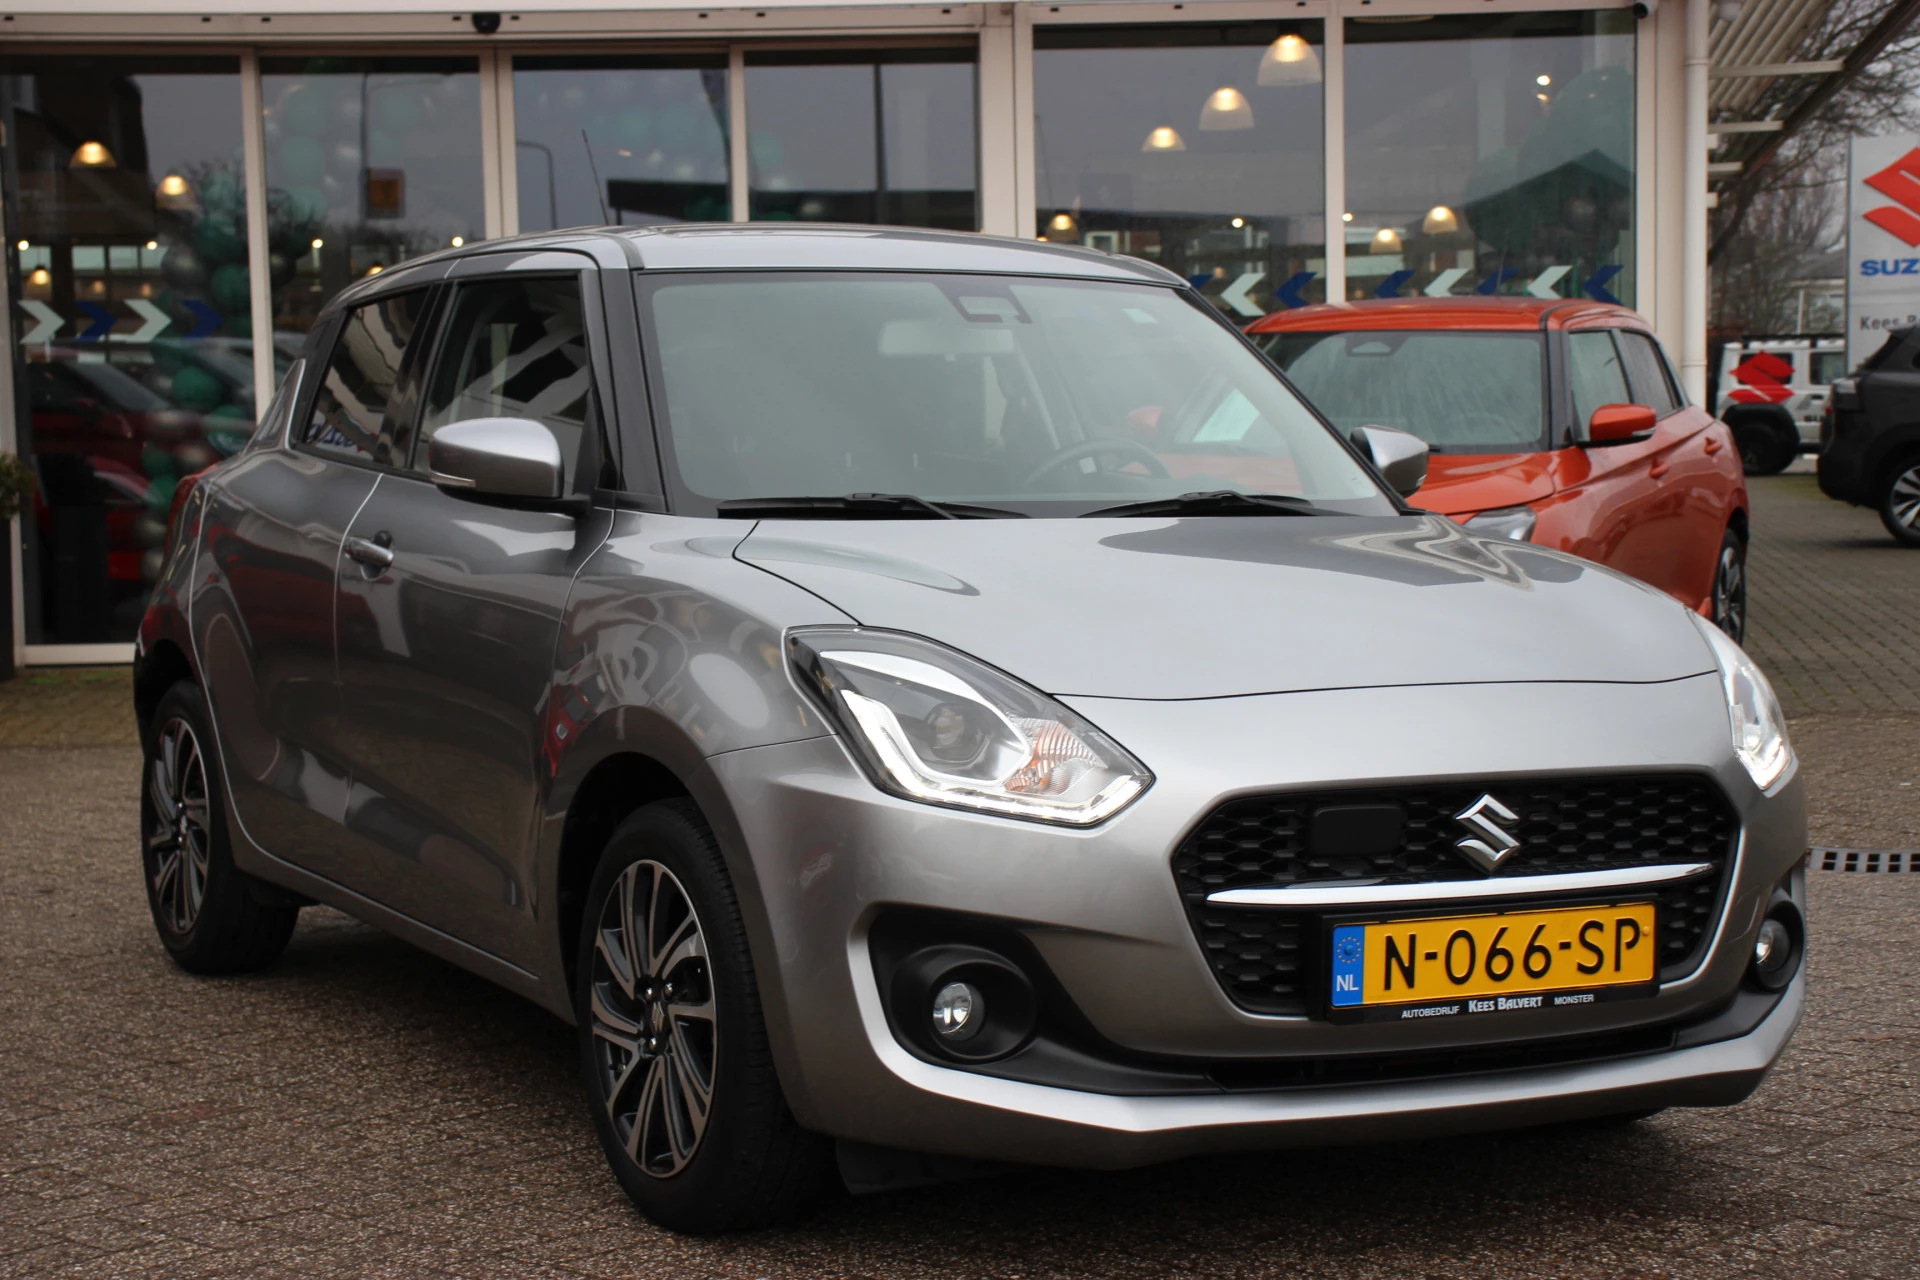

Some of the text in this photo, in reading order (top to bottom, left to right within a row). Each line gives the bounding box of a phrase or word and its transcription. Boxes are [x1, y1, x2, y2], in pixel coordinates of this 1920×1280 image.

[1383, 917, 1641, 992] N-066-SP
[1336, 974, 1359, 992] NL
[1401, 1005, 1460, 1019] AUTOBEDRIJF
[1554, 994, 1595, 1006] MONSTER
